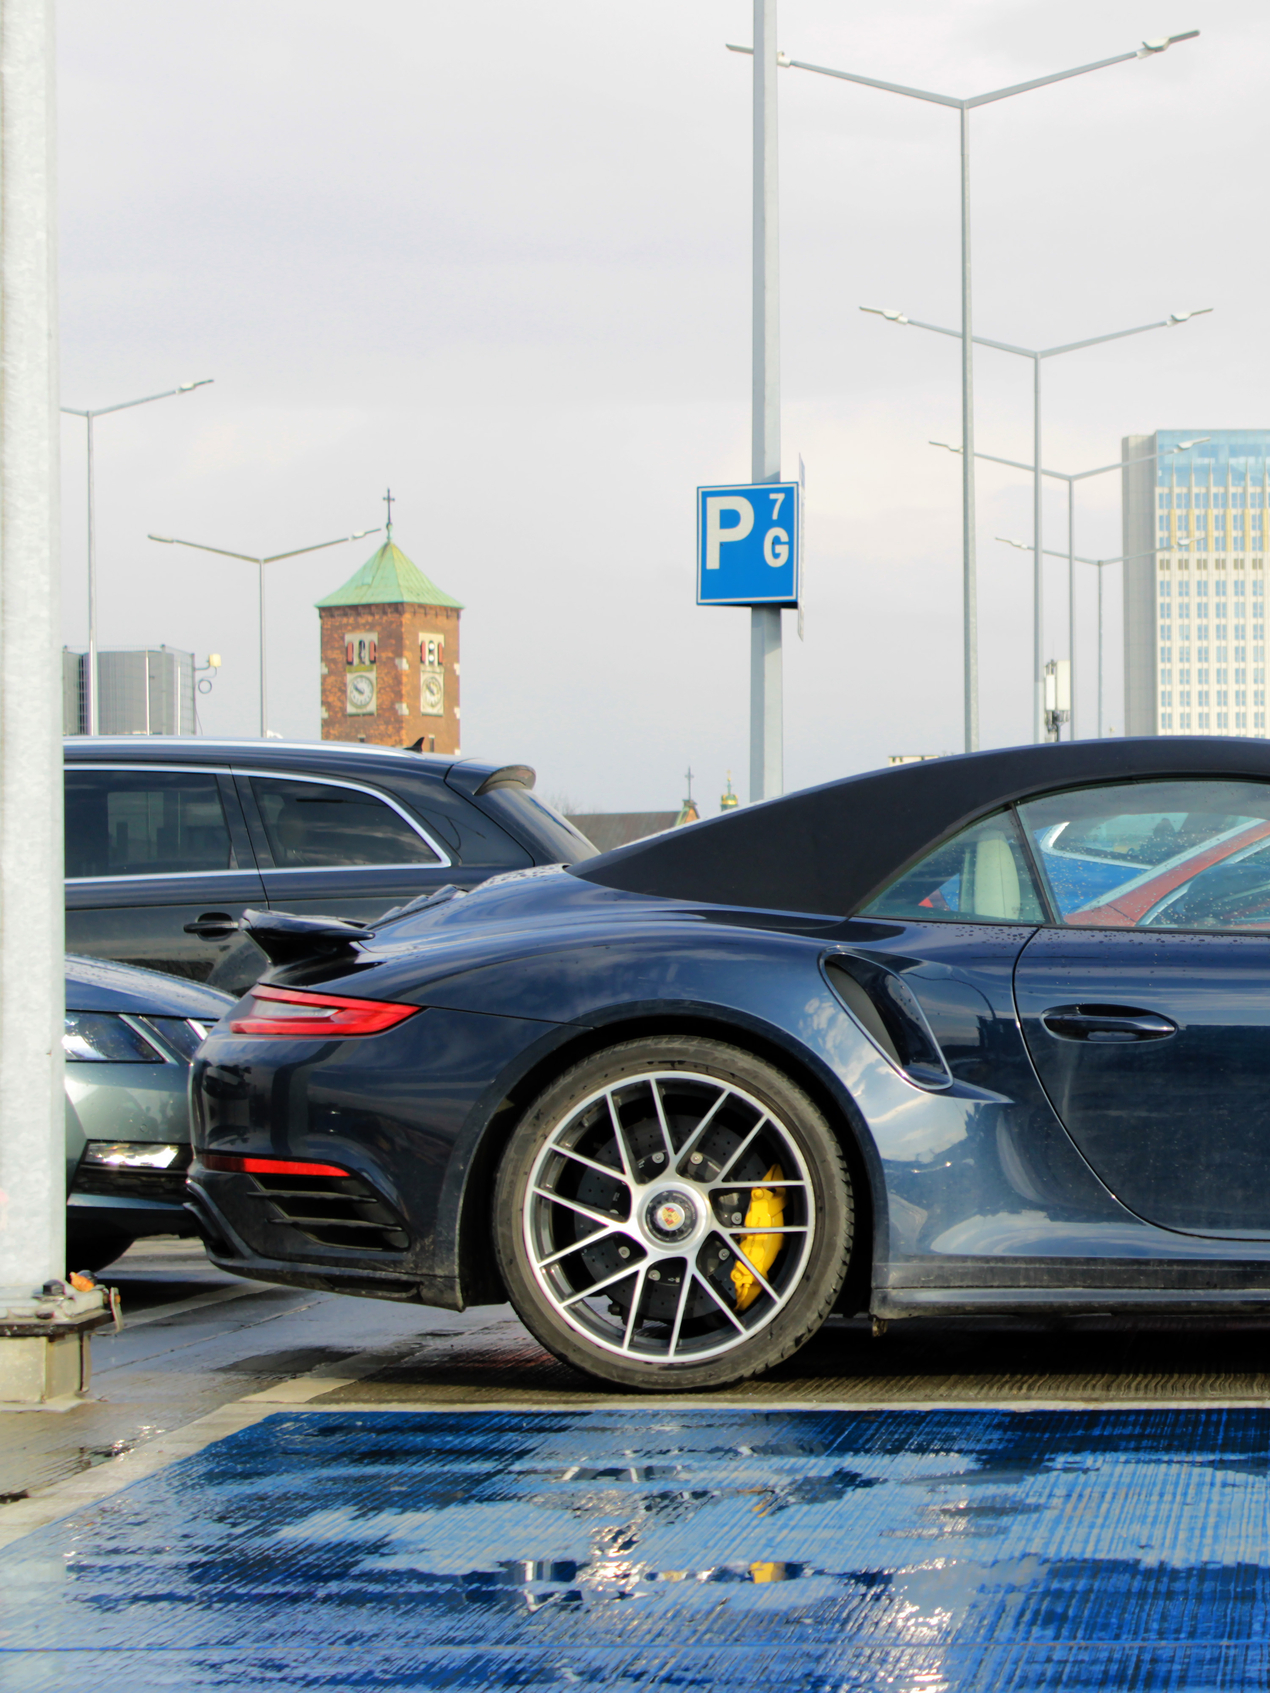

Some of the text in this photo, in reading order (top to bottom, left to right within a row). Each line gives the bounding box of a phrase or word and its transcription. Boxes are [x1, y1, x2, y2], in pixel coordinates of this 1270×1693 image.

[769, 493, 785, 520] 7
[706, 495, 755, 570] P
[763, 527, 789, 567] G
